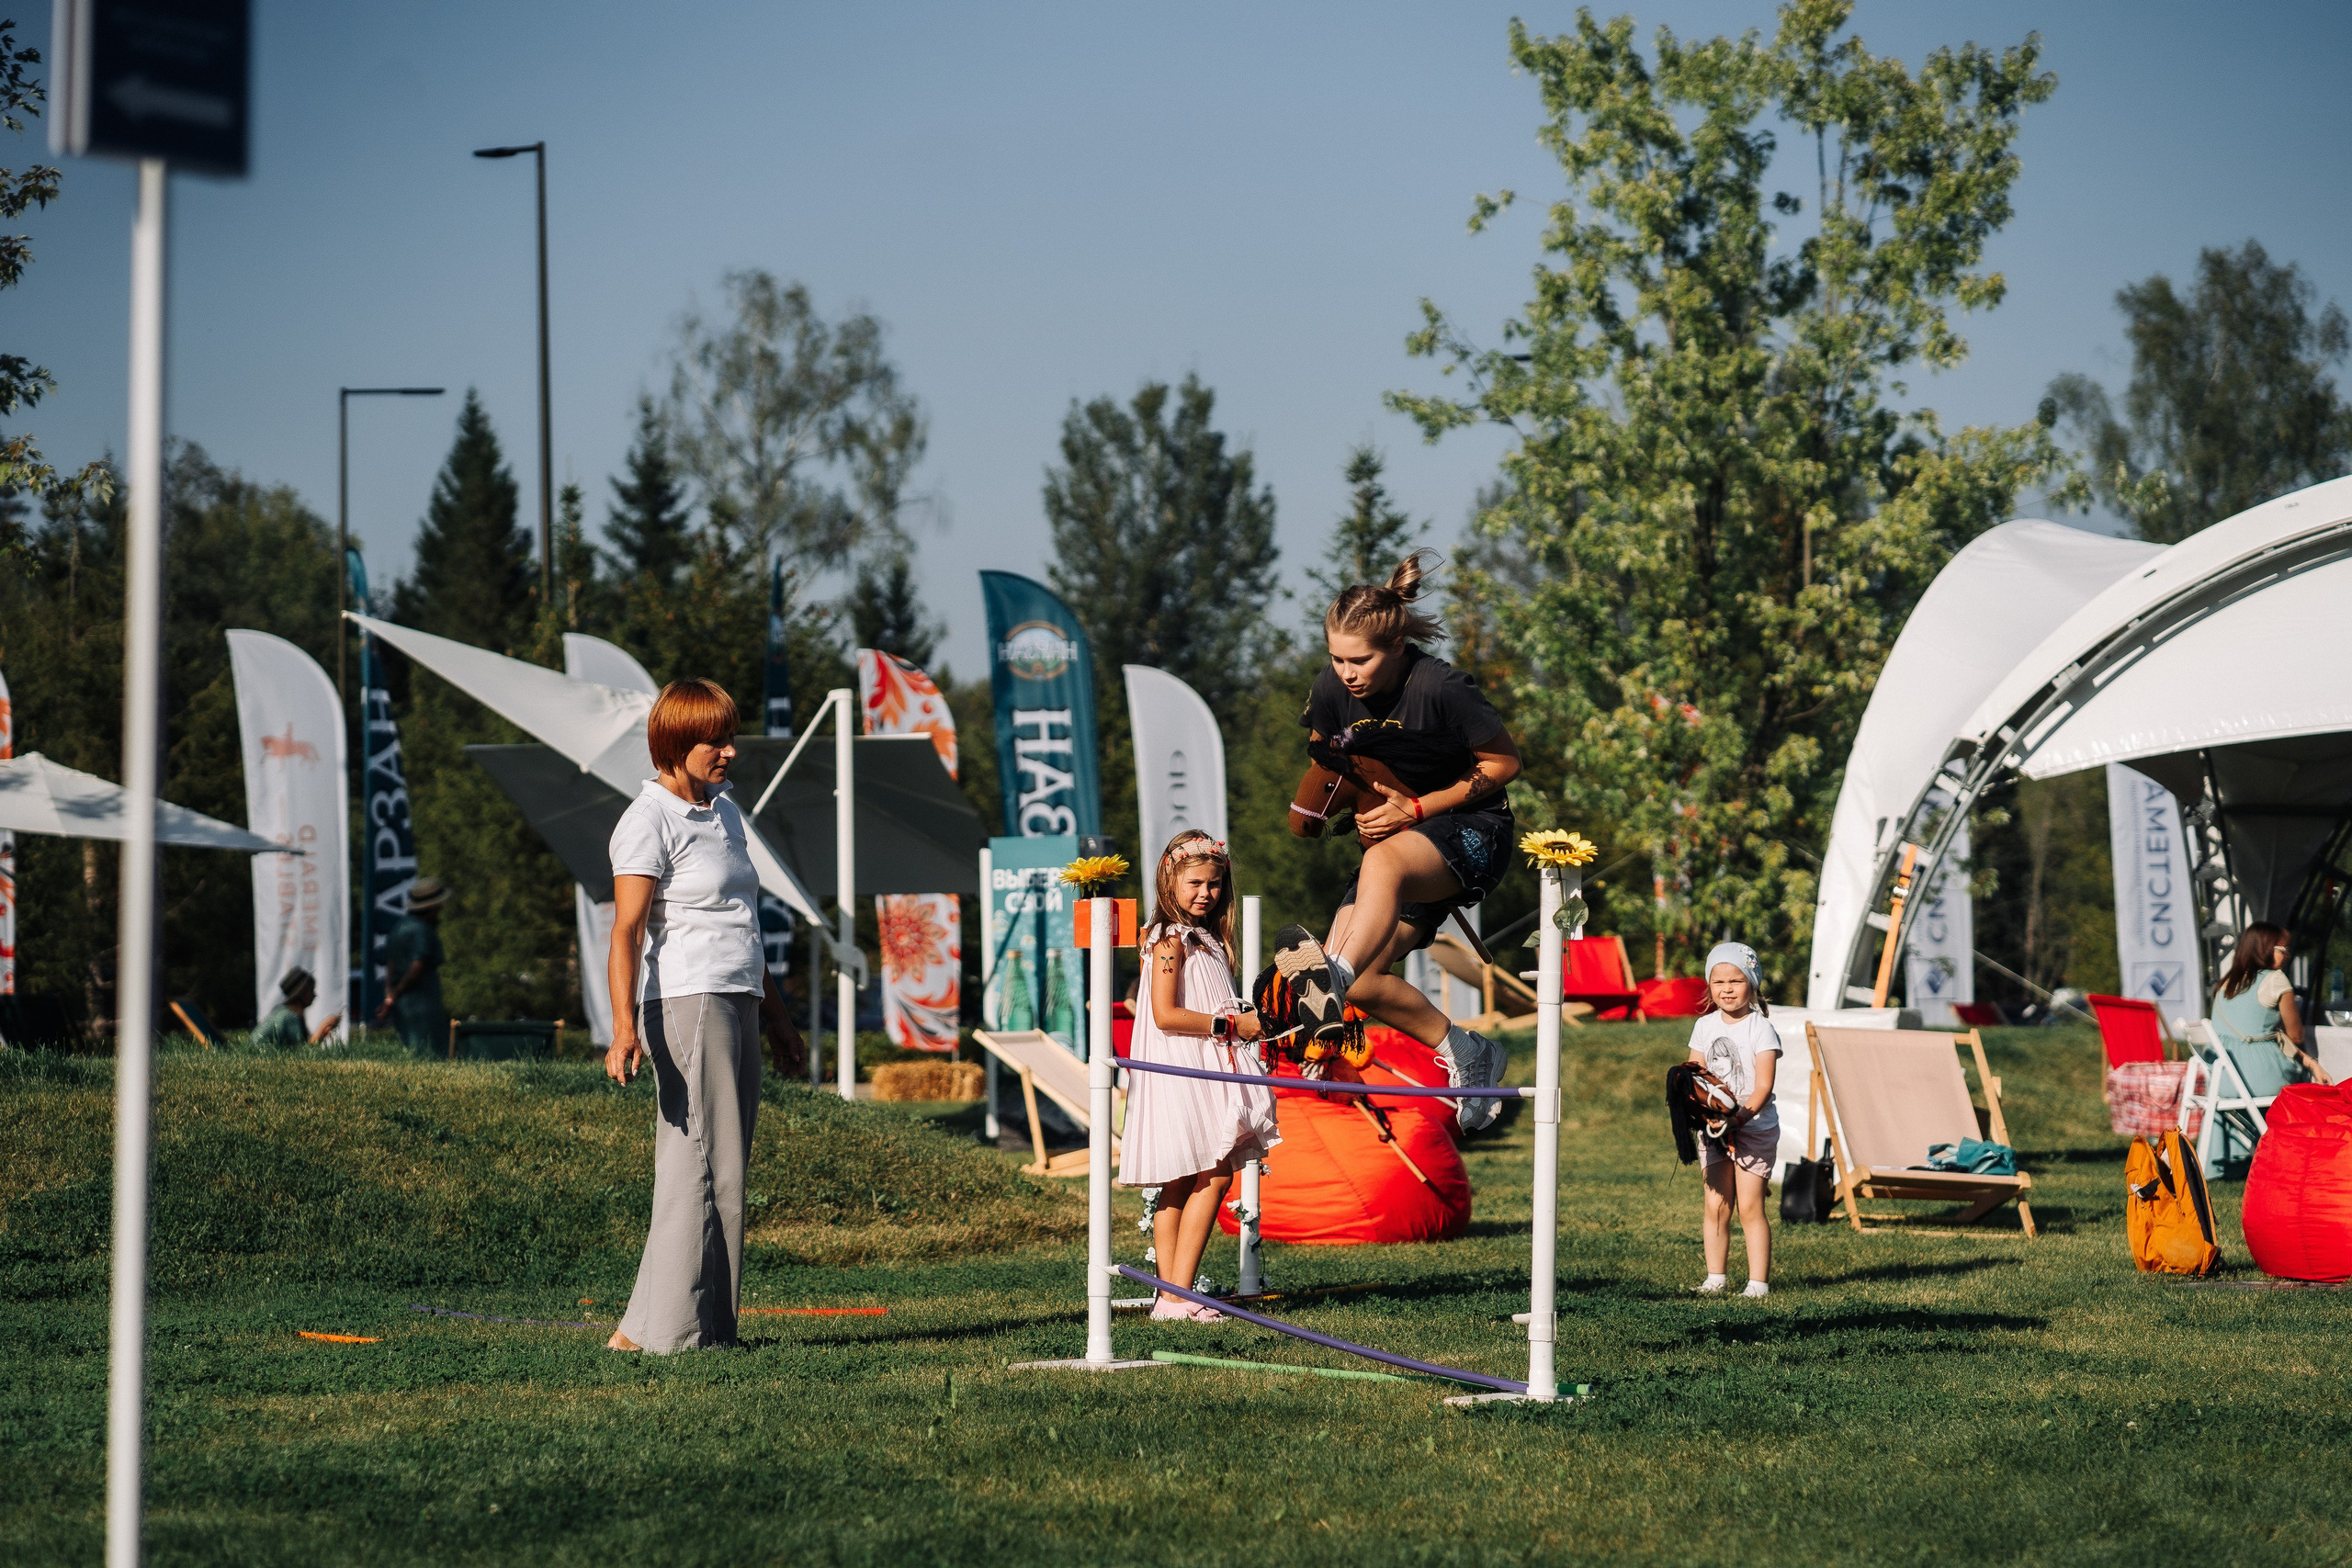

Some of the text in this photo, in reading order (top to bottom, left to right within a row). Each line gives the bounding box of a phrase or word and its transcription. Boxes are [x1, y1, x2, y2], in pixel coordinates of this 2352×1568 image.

[368, 689, 417, 980] АРЗАН
[992, 867, 1075, 890] ВЫБЕР
[1004, 887, 1064, 914] СВОЙ
